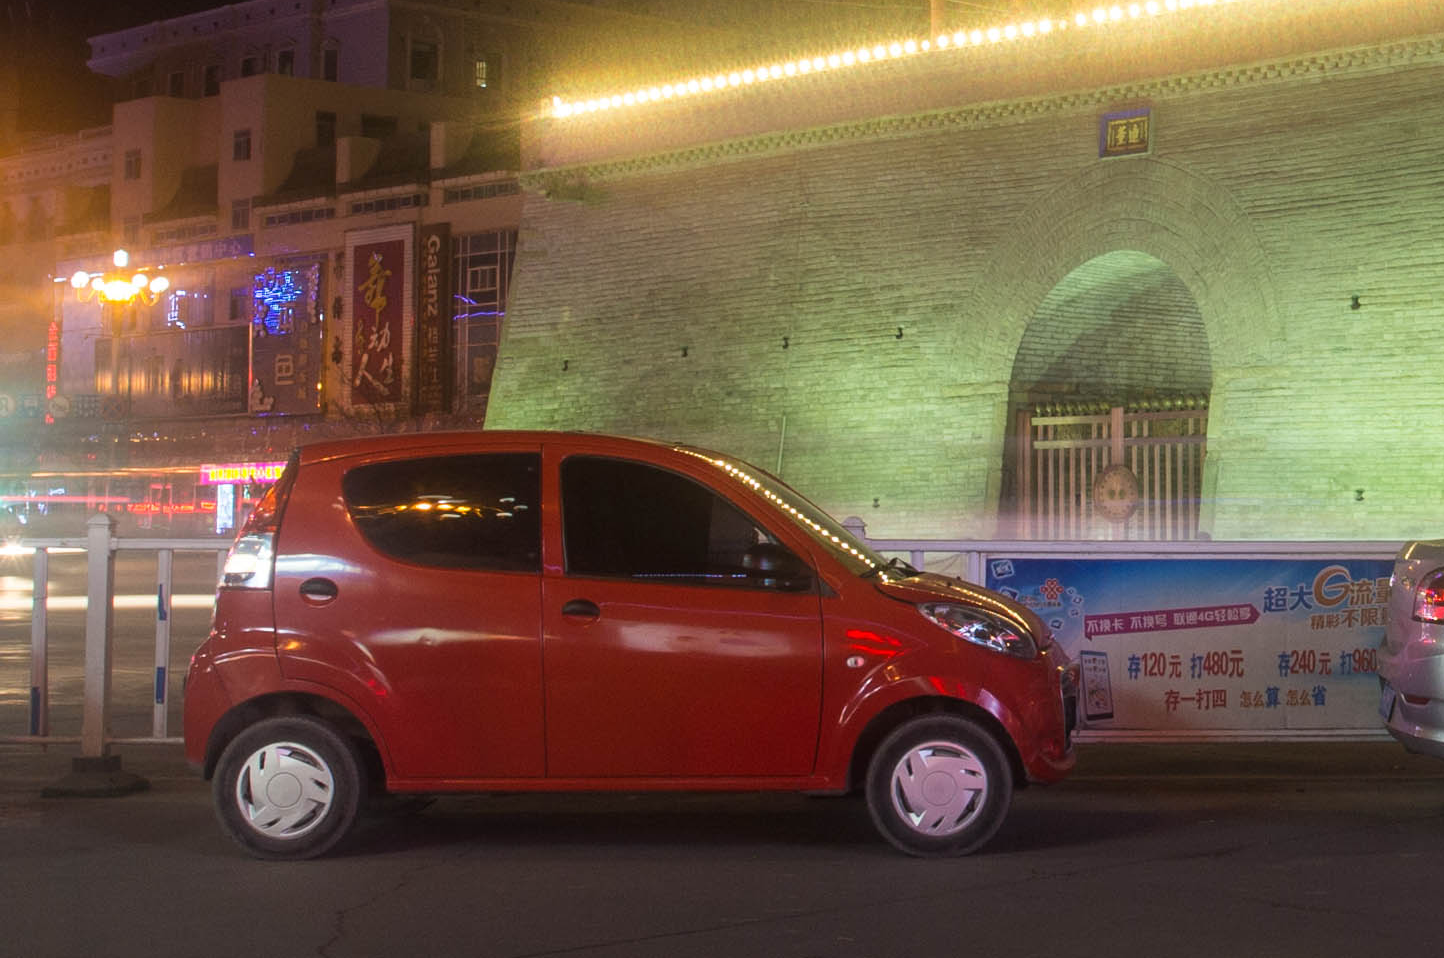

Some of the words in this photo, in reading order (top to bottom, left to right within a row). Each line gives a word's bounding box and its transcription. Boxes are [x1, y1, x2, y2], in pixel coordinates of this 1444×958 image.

[426, 233, 441, 316] Galanz
[1086, 617, 1126, 633] 不换卡
[1164, 688, 1228, 713] 存一打四
[1240, 686, 1280, 709] 怎么算
[1286, 684, 1327, 707] 怎么省
